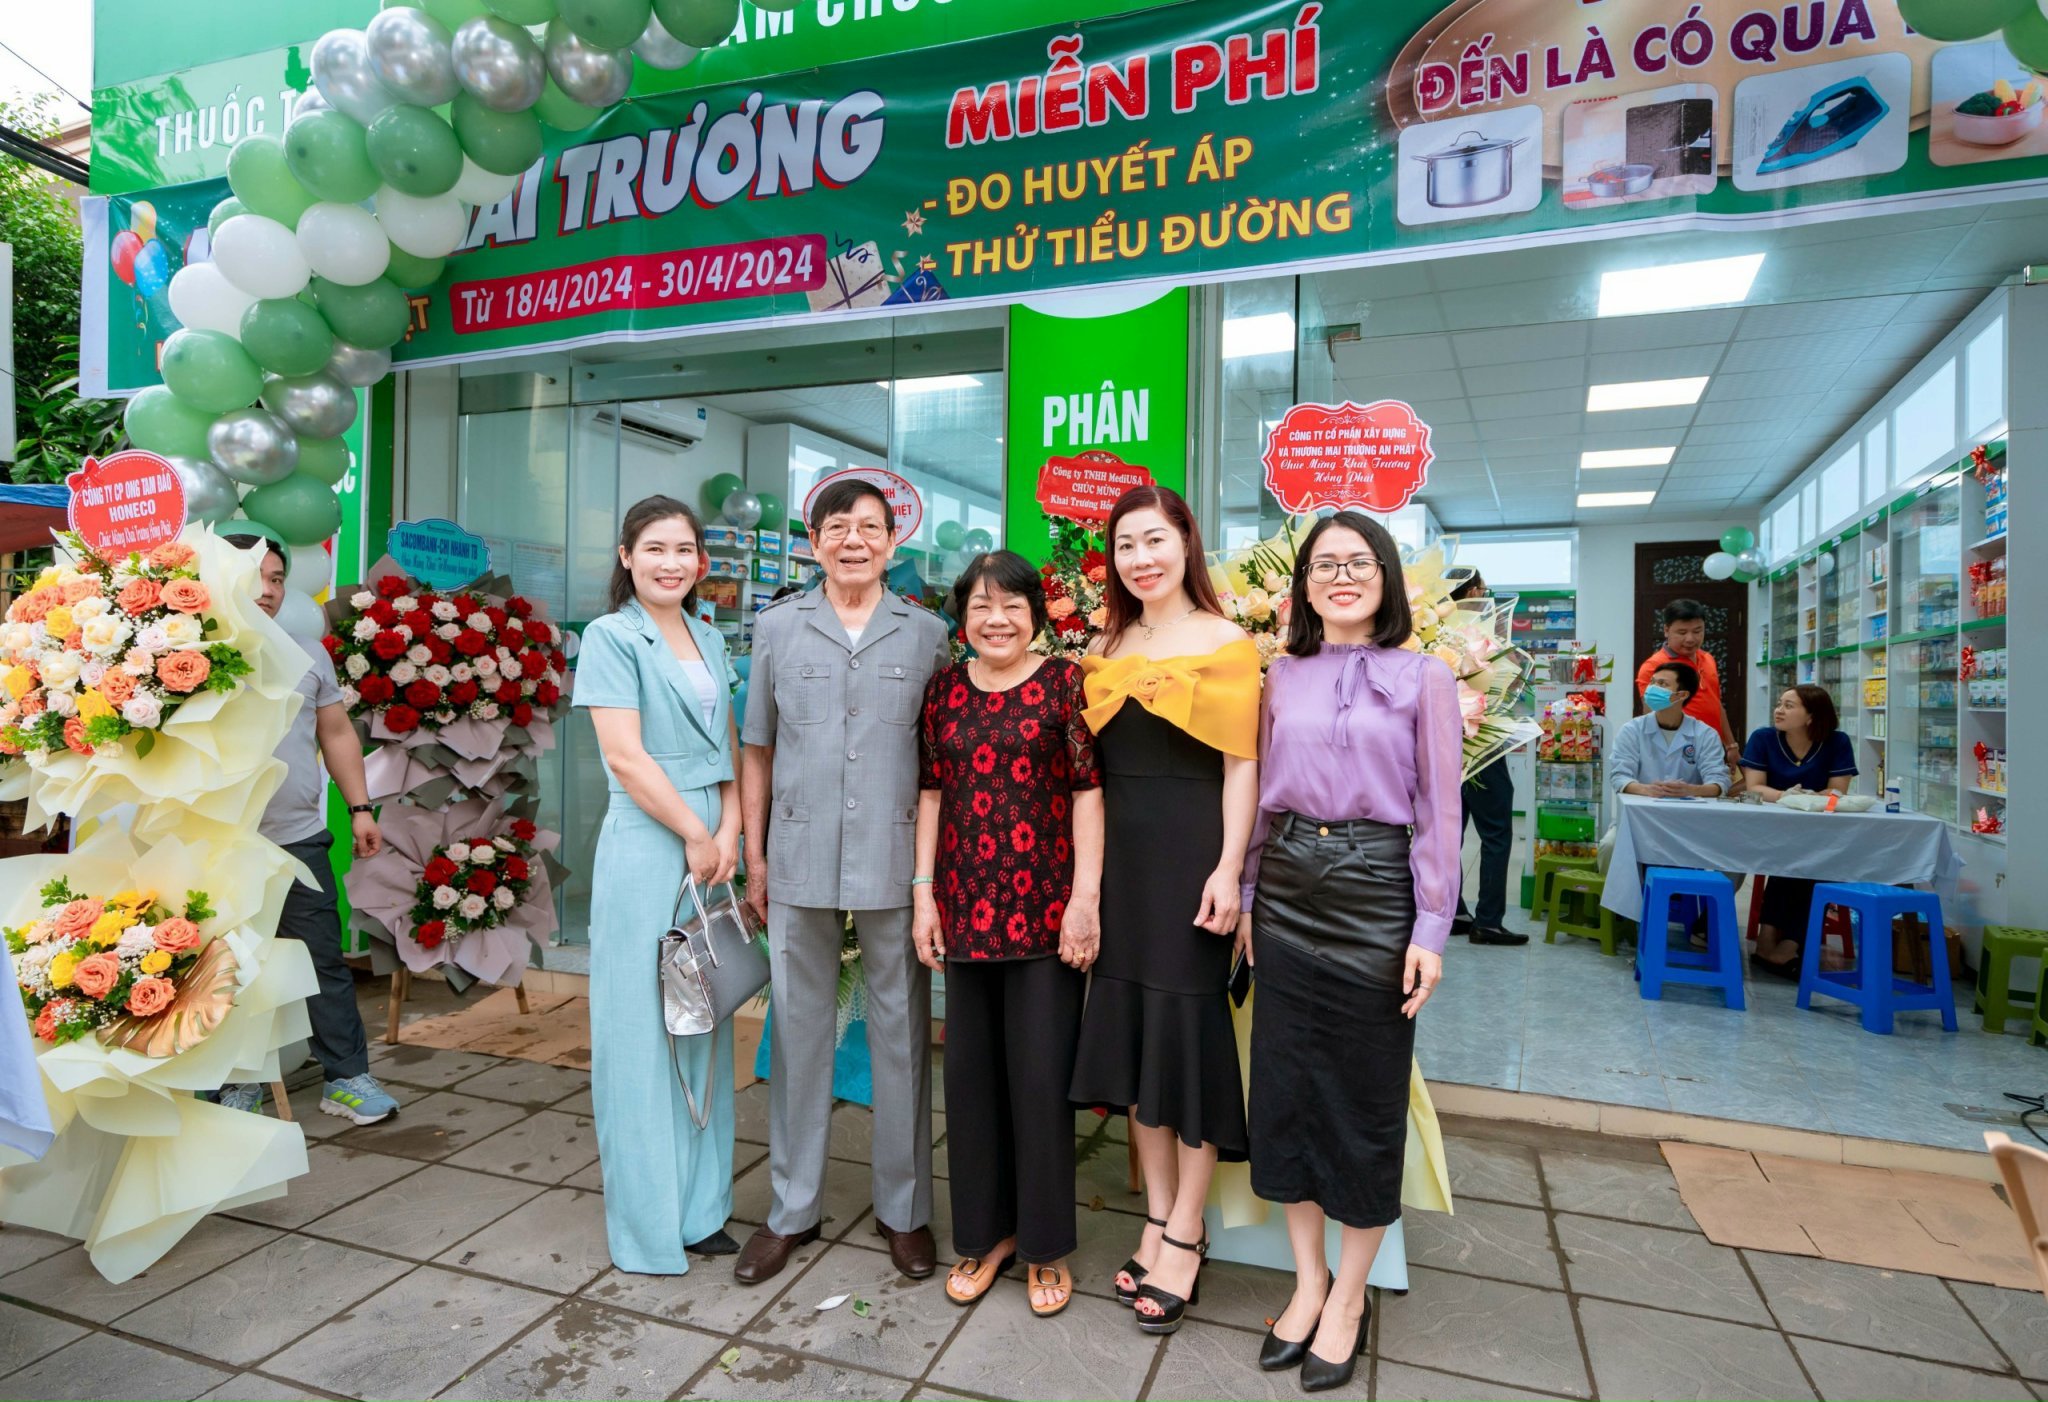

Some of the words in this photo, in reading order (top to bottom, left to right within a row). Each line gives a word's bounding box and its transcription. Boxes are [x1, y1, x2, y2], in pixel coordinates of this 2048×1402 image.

[1417, 32, 1529, 111] ĐẾN
[1544, 26, 1617, 91] LÀ
[1632, 4, 1715, 73] CÓ
[945, 33, 1149, 149] MIỄN
[1171, 2, 1323, 114] PHÍ
[154, 84, 265, 158] THUỐC
[554, 89, 886, 236] TRƯƠNG
[946, 173, 1012, 218] ĐO
[1023, 138, 1176, 205] HUYẾT
[1187, 132, 1254, 183] ÁP
[946, 223, 1041, 277] THỬ
[1047, 210, 1149, 267] TIỂU
[1160, 192, 1352, 254] ĐƯỜNG
[461, 289, 495, 325] Từ
[504, 265, 633, 319] 18/4/2024
[657, 244, 813, 298] 30/4/2024
[1043, 379, 1149, 447] PHÂN
[1289, 430, 1311, 442] CÔNG
[1314, 430, 1323, 440] TY
[1363, 427, 1380, 439] XÂY
[1382, 428, 1406, 440] DỰNG
[1278, 445, 1289, 457] VÀ
[1325, 446, 1341, 458] MẠI
[1379, 445, 1391, 455] AN
[1393, 443, 1416, 455] PHÁT
[1339, 457, 1368, 469] Khai
[1052, 466, 1072, 480] Công
[1073, 470, 1081, 480] ty
[1084, 470, 1107, 481] TNHH
[1109, 473, 1143, 486] MediUSA
[1347, 471, 1374, 483] Phát
[104, 484, 113, 503] TY
[114, 482, 124, 501] CP
[125, 479, 141, 499] ONG
[1072, 482, 1095, 494] CHÚC
[1096, 484, 1121, 497] MỪNG
[108, 498, 156, 523] HONECO
[892, 503, 912, 518] VIỆT
[1050, 494, 1068, 505] Khai
[1100, 499, 1116, 511] Hồn
